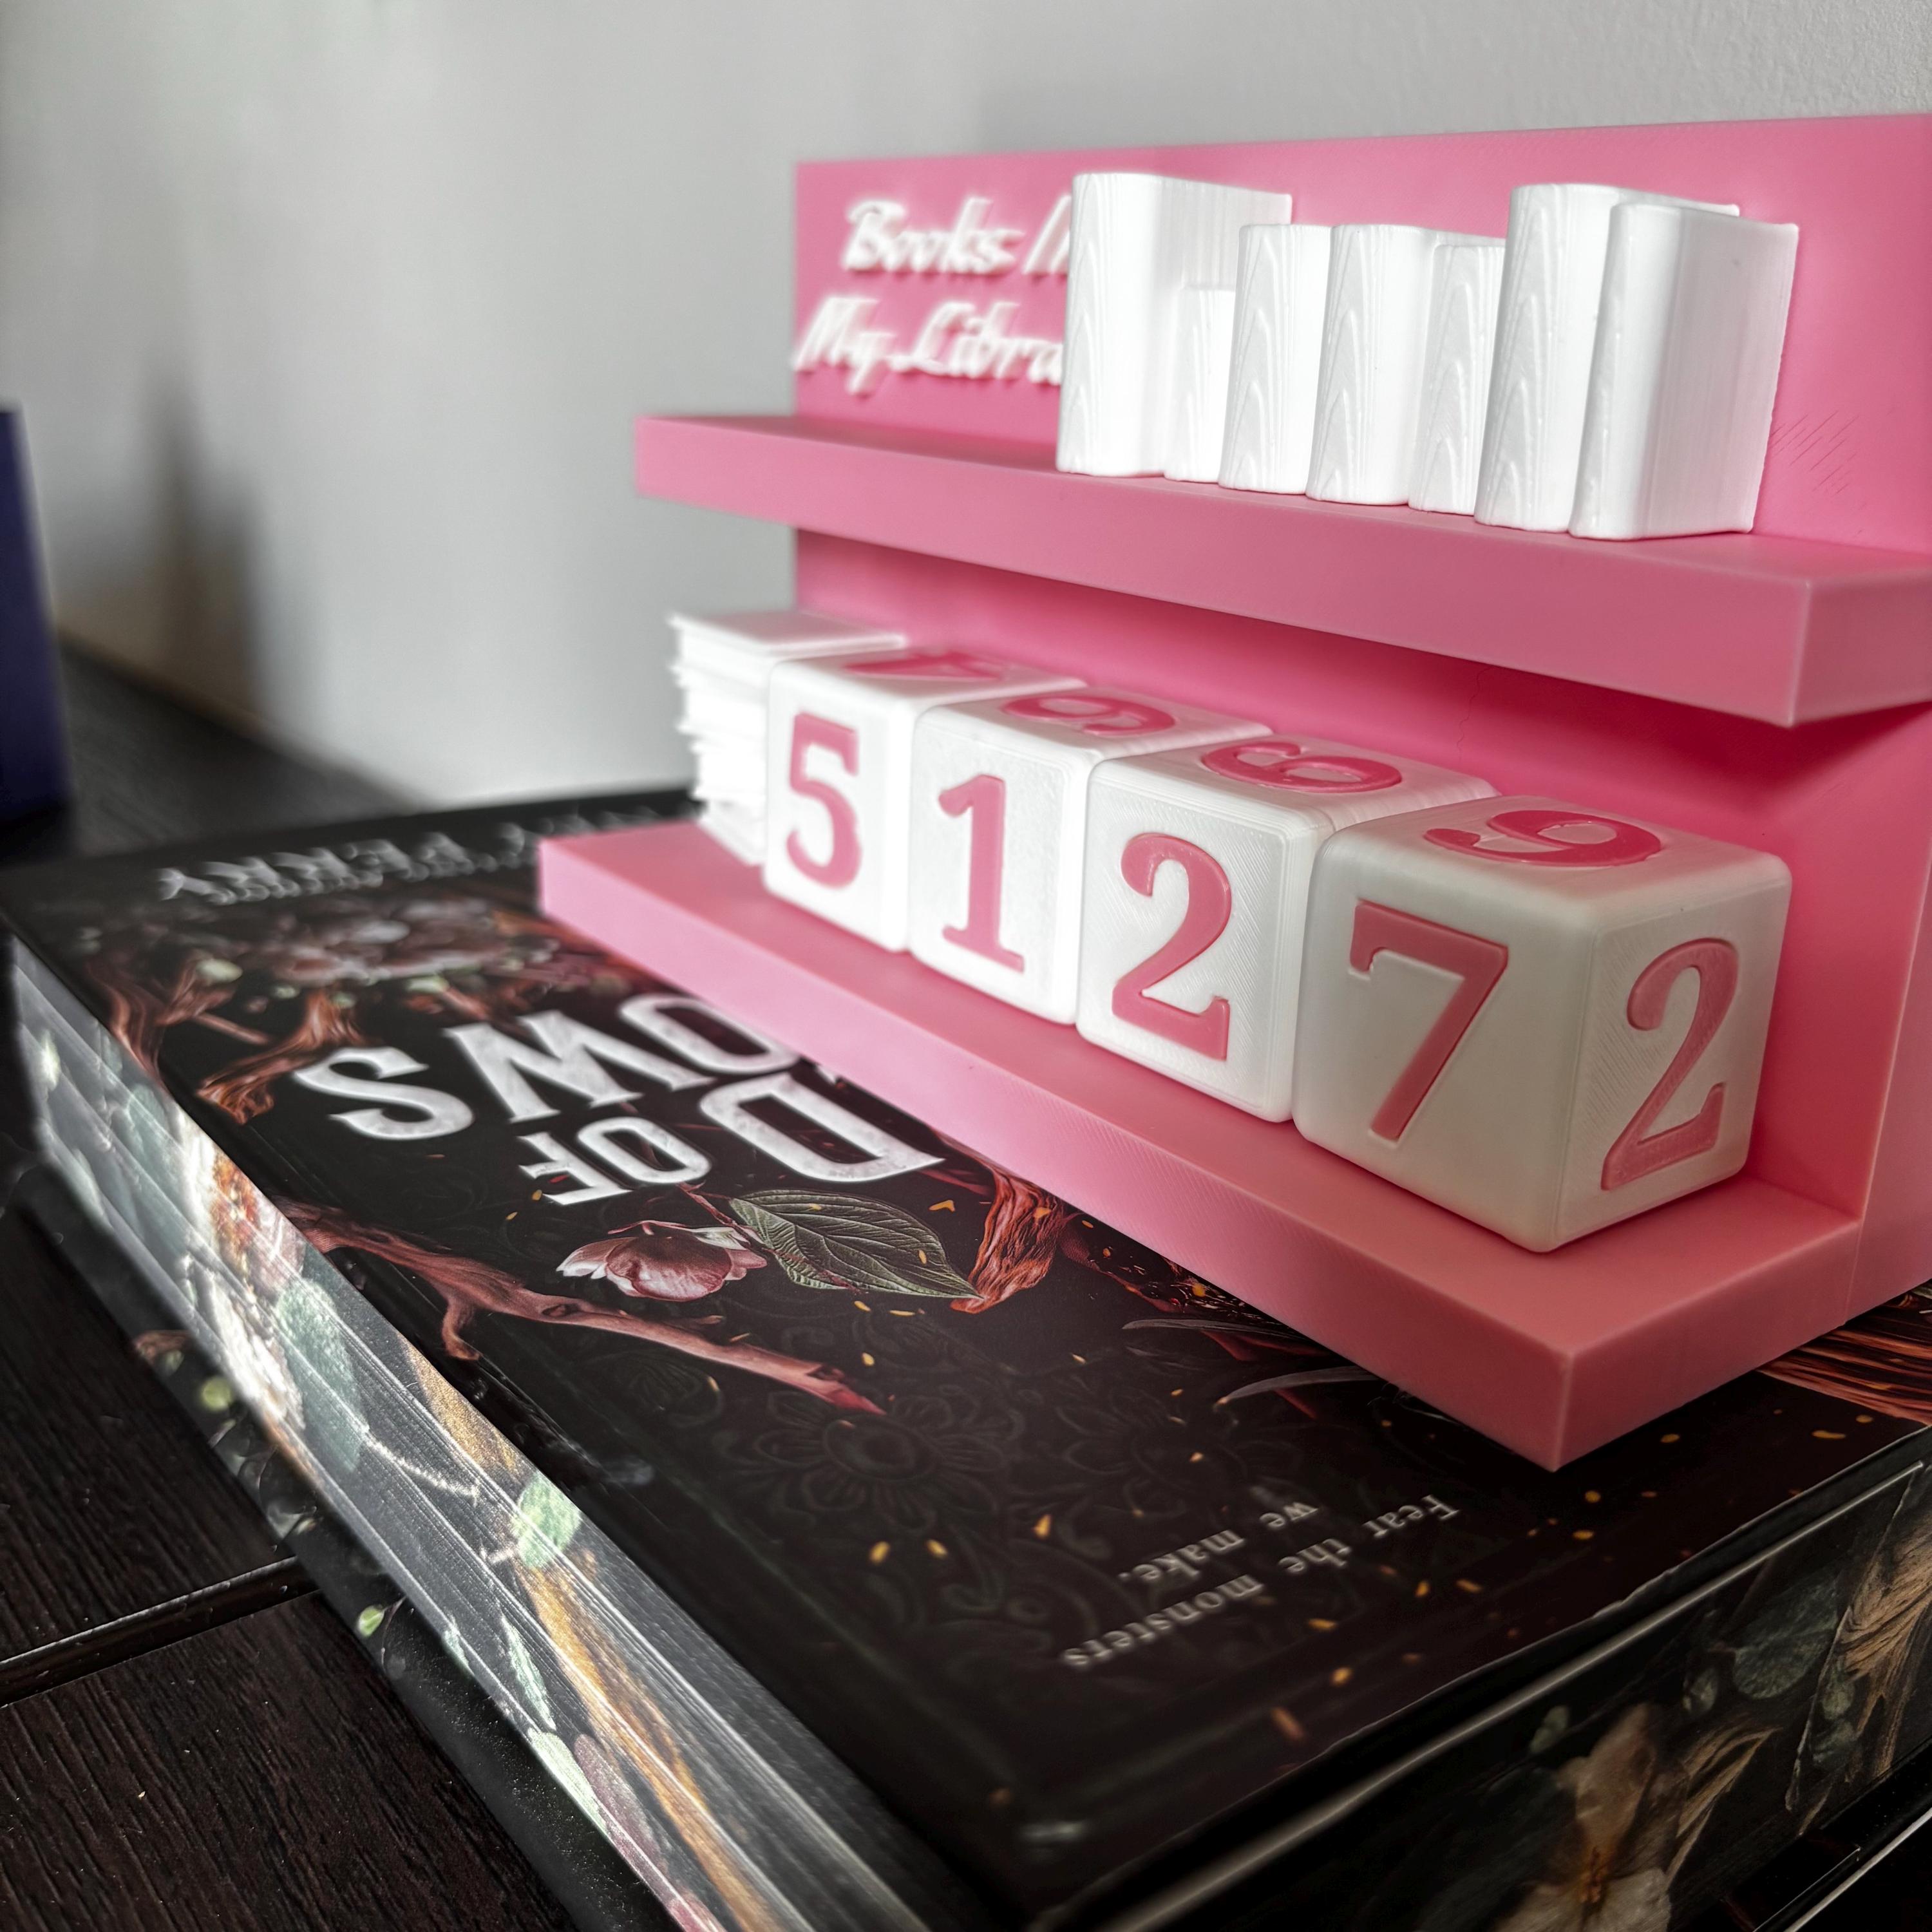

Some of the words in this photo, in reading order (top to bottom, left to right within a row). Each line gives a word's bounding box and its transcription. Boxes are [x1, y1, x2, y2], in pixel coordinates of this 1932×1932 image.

[842, 195, 1025, 275] Books
[793, 295, 896, 395] My
[888, 299, 1065, 386] Libra
[785, 710, 862, 889] 5
[938, 773, 1025, 974] 1
[1112, 831, 1233, 1062] 2
[1349, 898, 1509, 1144] 7
[1600, 937, 1739, 1191] 2
[516, 1115, 712, 1206] OF
[1117, 1529, 1245, 1584] make.
[1258, 1501, 1320, 1531] we
[1277, 1537, 1352, 1576] the
[1361, 1494, 1461, 1539] Fear
[1062, 1574, 1265, 1669] monsters
